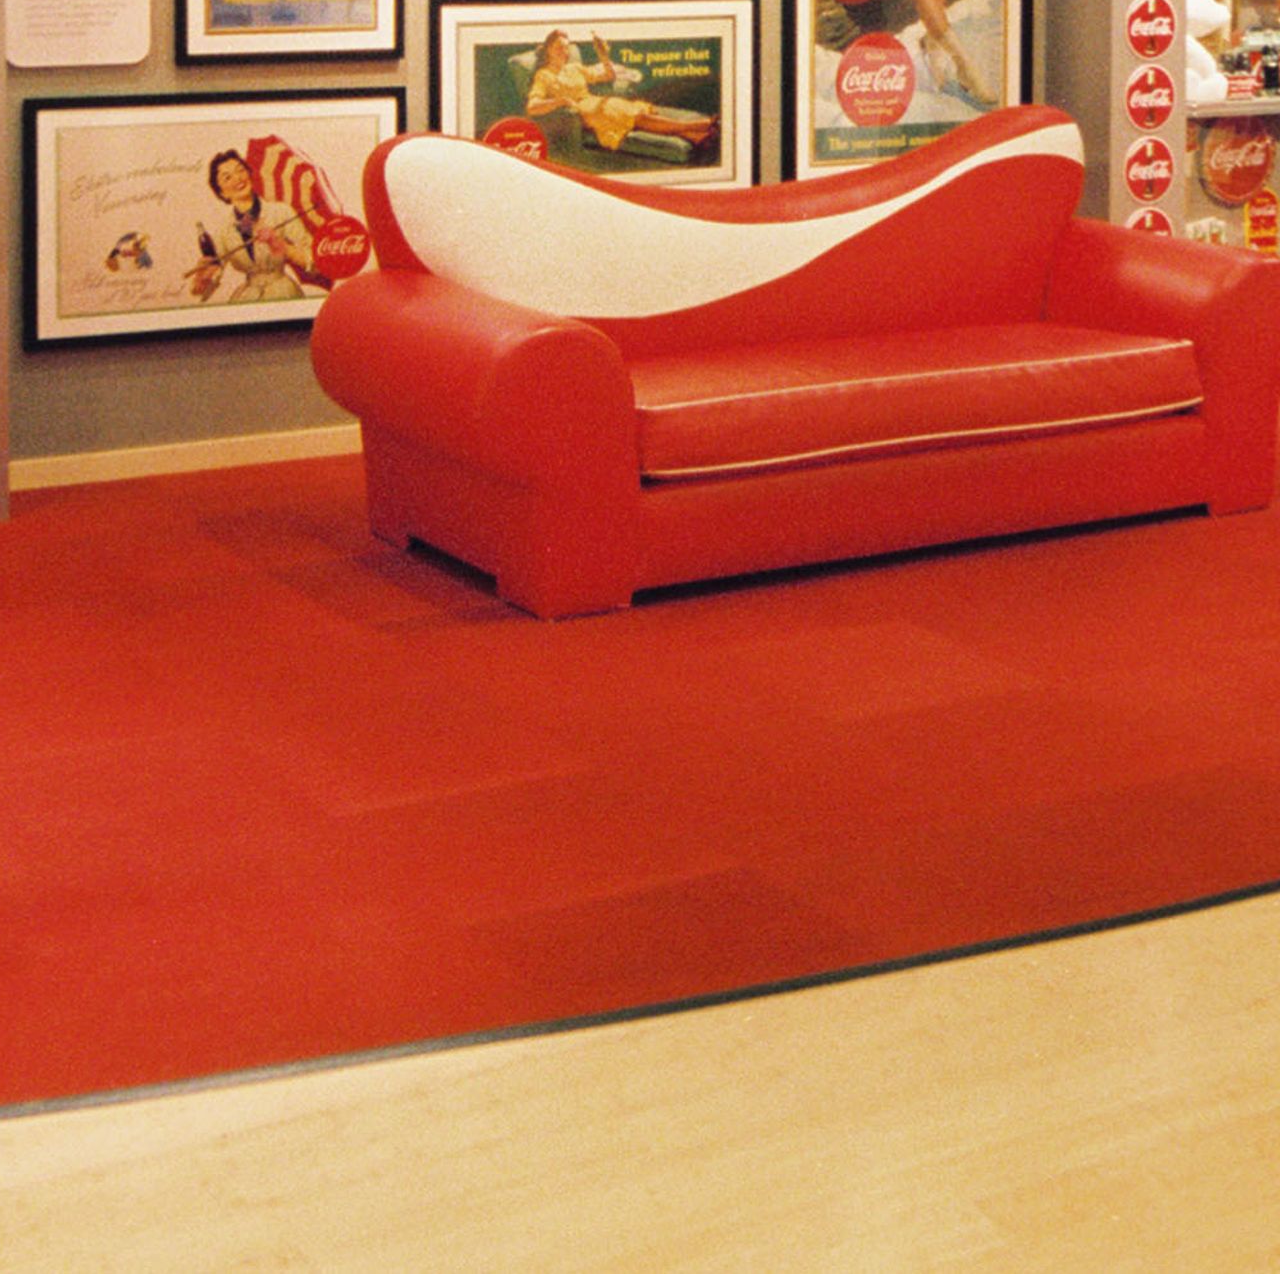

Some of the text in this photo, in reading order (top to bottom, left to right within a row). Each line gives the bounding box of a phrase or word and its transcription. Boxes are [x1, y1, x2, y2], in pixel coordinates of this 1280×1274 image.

[619, 47, 710, 66] The pause that
[651, 62, 710, 78] refreshes
[842, 64, 907, 94] Coca-Cola
[828, 137, 848, 151] The
[1210, 138, 1267, 173] Coca-Cola
[317, 235, 365, 256] Coca-Cola
